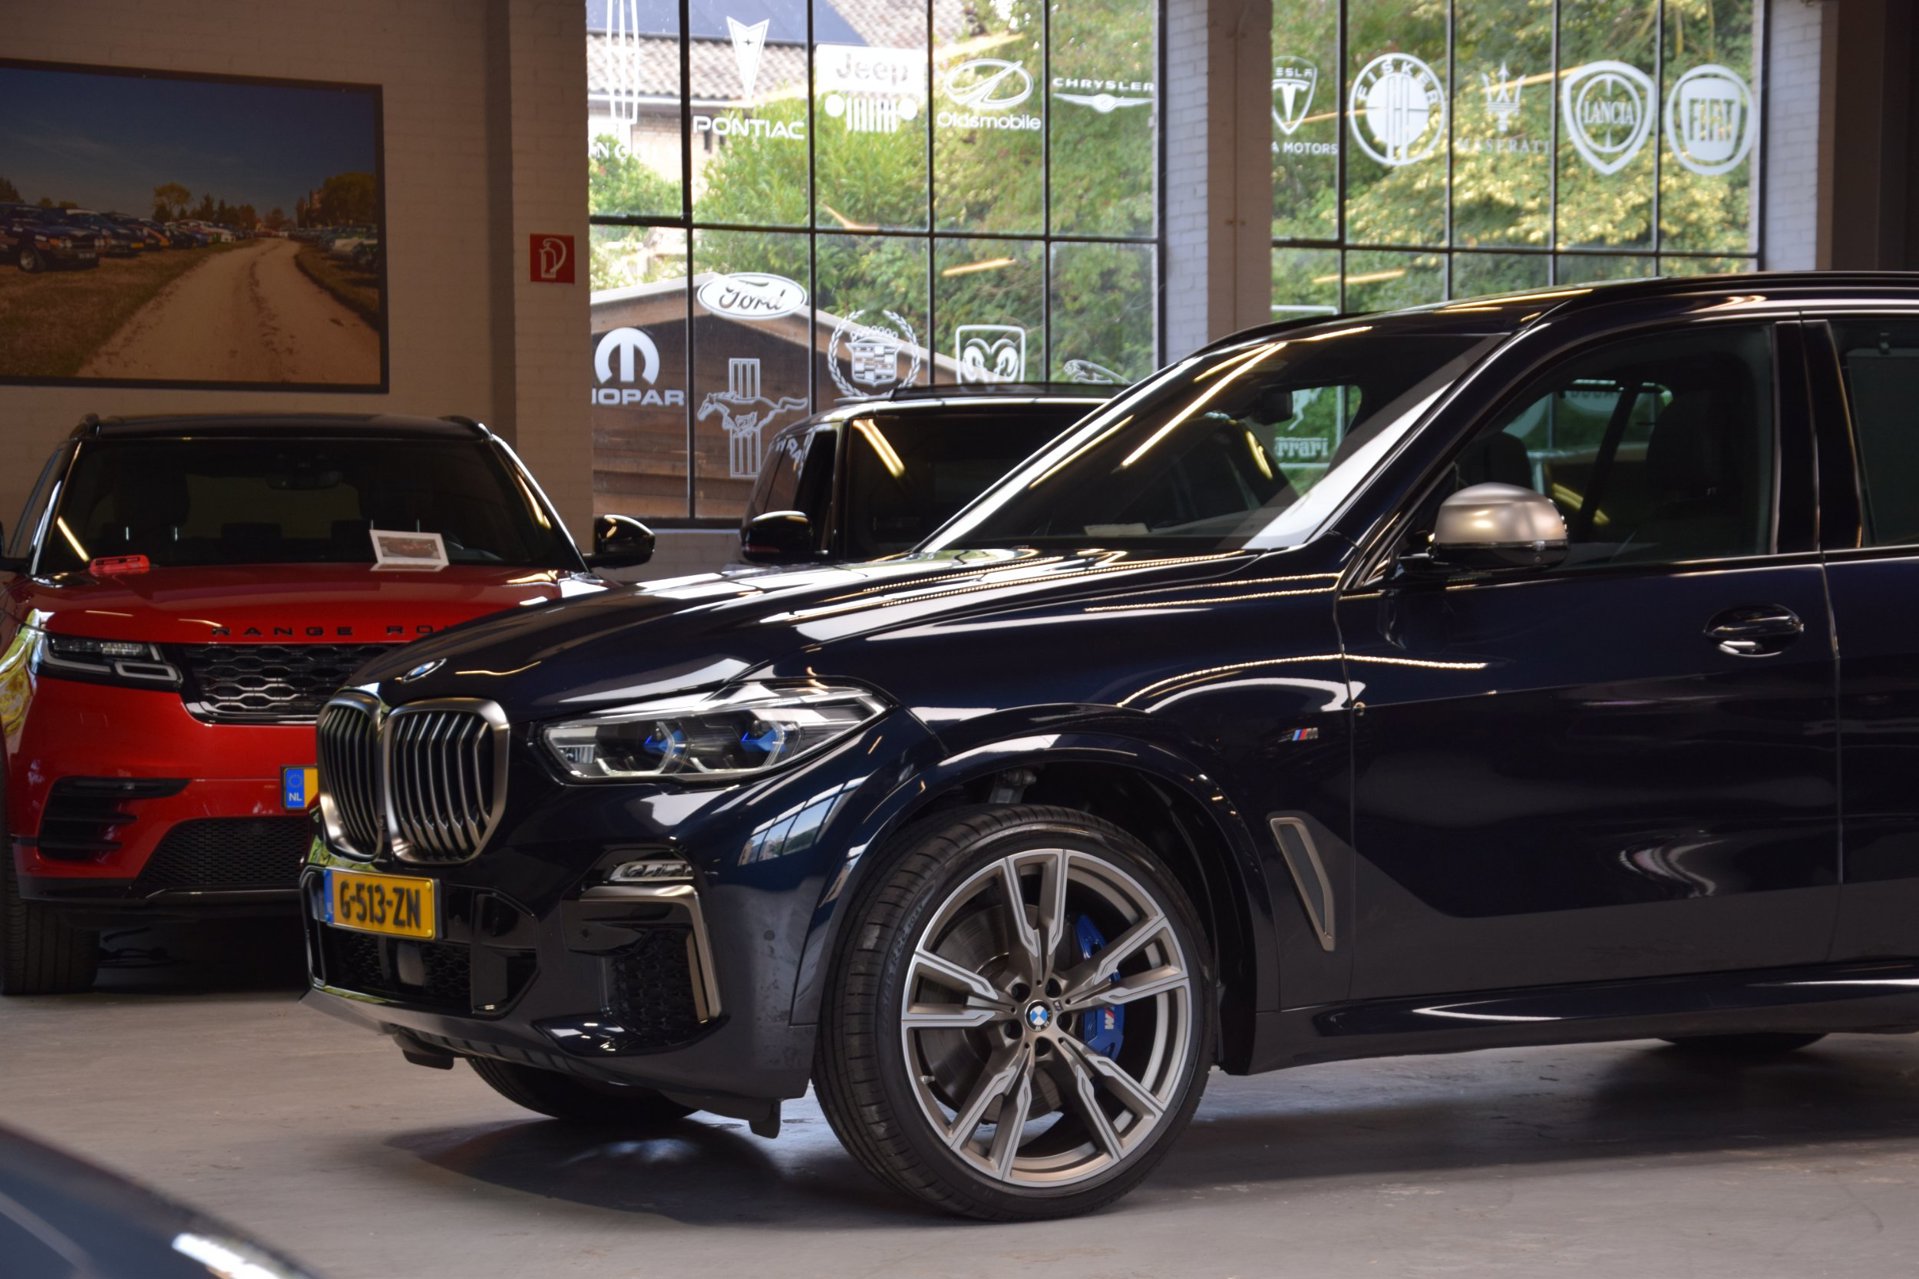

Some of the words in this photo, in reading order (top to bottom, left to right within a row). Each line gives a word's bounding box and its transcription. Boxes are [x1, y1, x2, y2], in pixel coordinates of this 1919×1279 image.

[835, 53, 908, 86] Jeep
[1275, 67, 1313, 77] ESLA
[1052, 77, 1155, 92] CHRYSLER
[936, 111, 1042, 131] Oldsmobile
[1584, 101, 1635, 125] LANCIA
[1689, 98, 1736, 141] FIAT
[692, 115, 805, 139] PONTIAC
[1283, 142, 1339, 155] MOTORS
[1455, 137, 1550, 154] MASERATI
[719, 279, 786, 311] Ford
[591, 387, 684, 406] OPAR
[1275, 436, 1329, 457] rrari
[212, 626, 353, 636] RANGE
[386, 625, 440, 635] RO
[289, 792, 303, 802] NL
[340, 880, 421, 930] G-513-ZN
